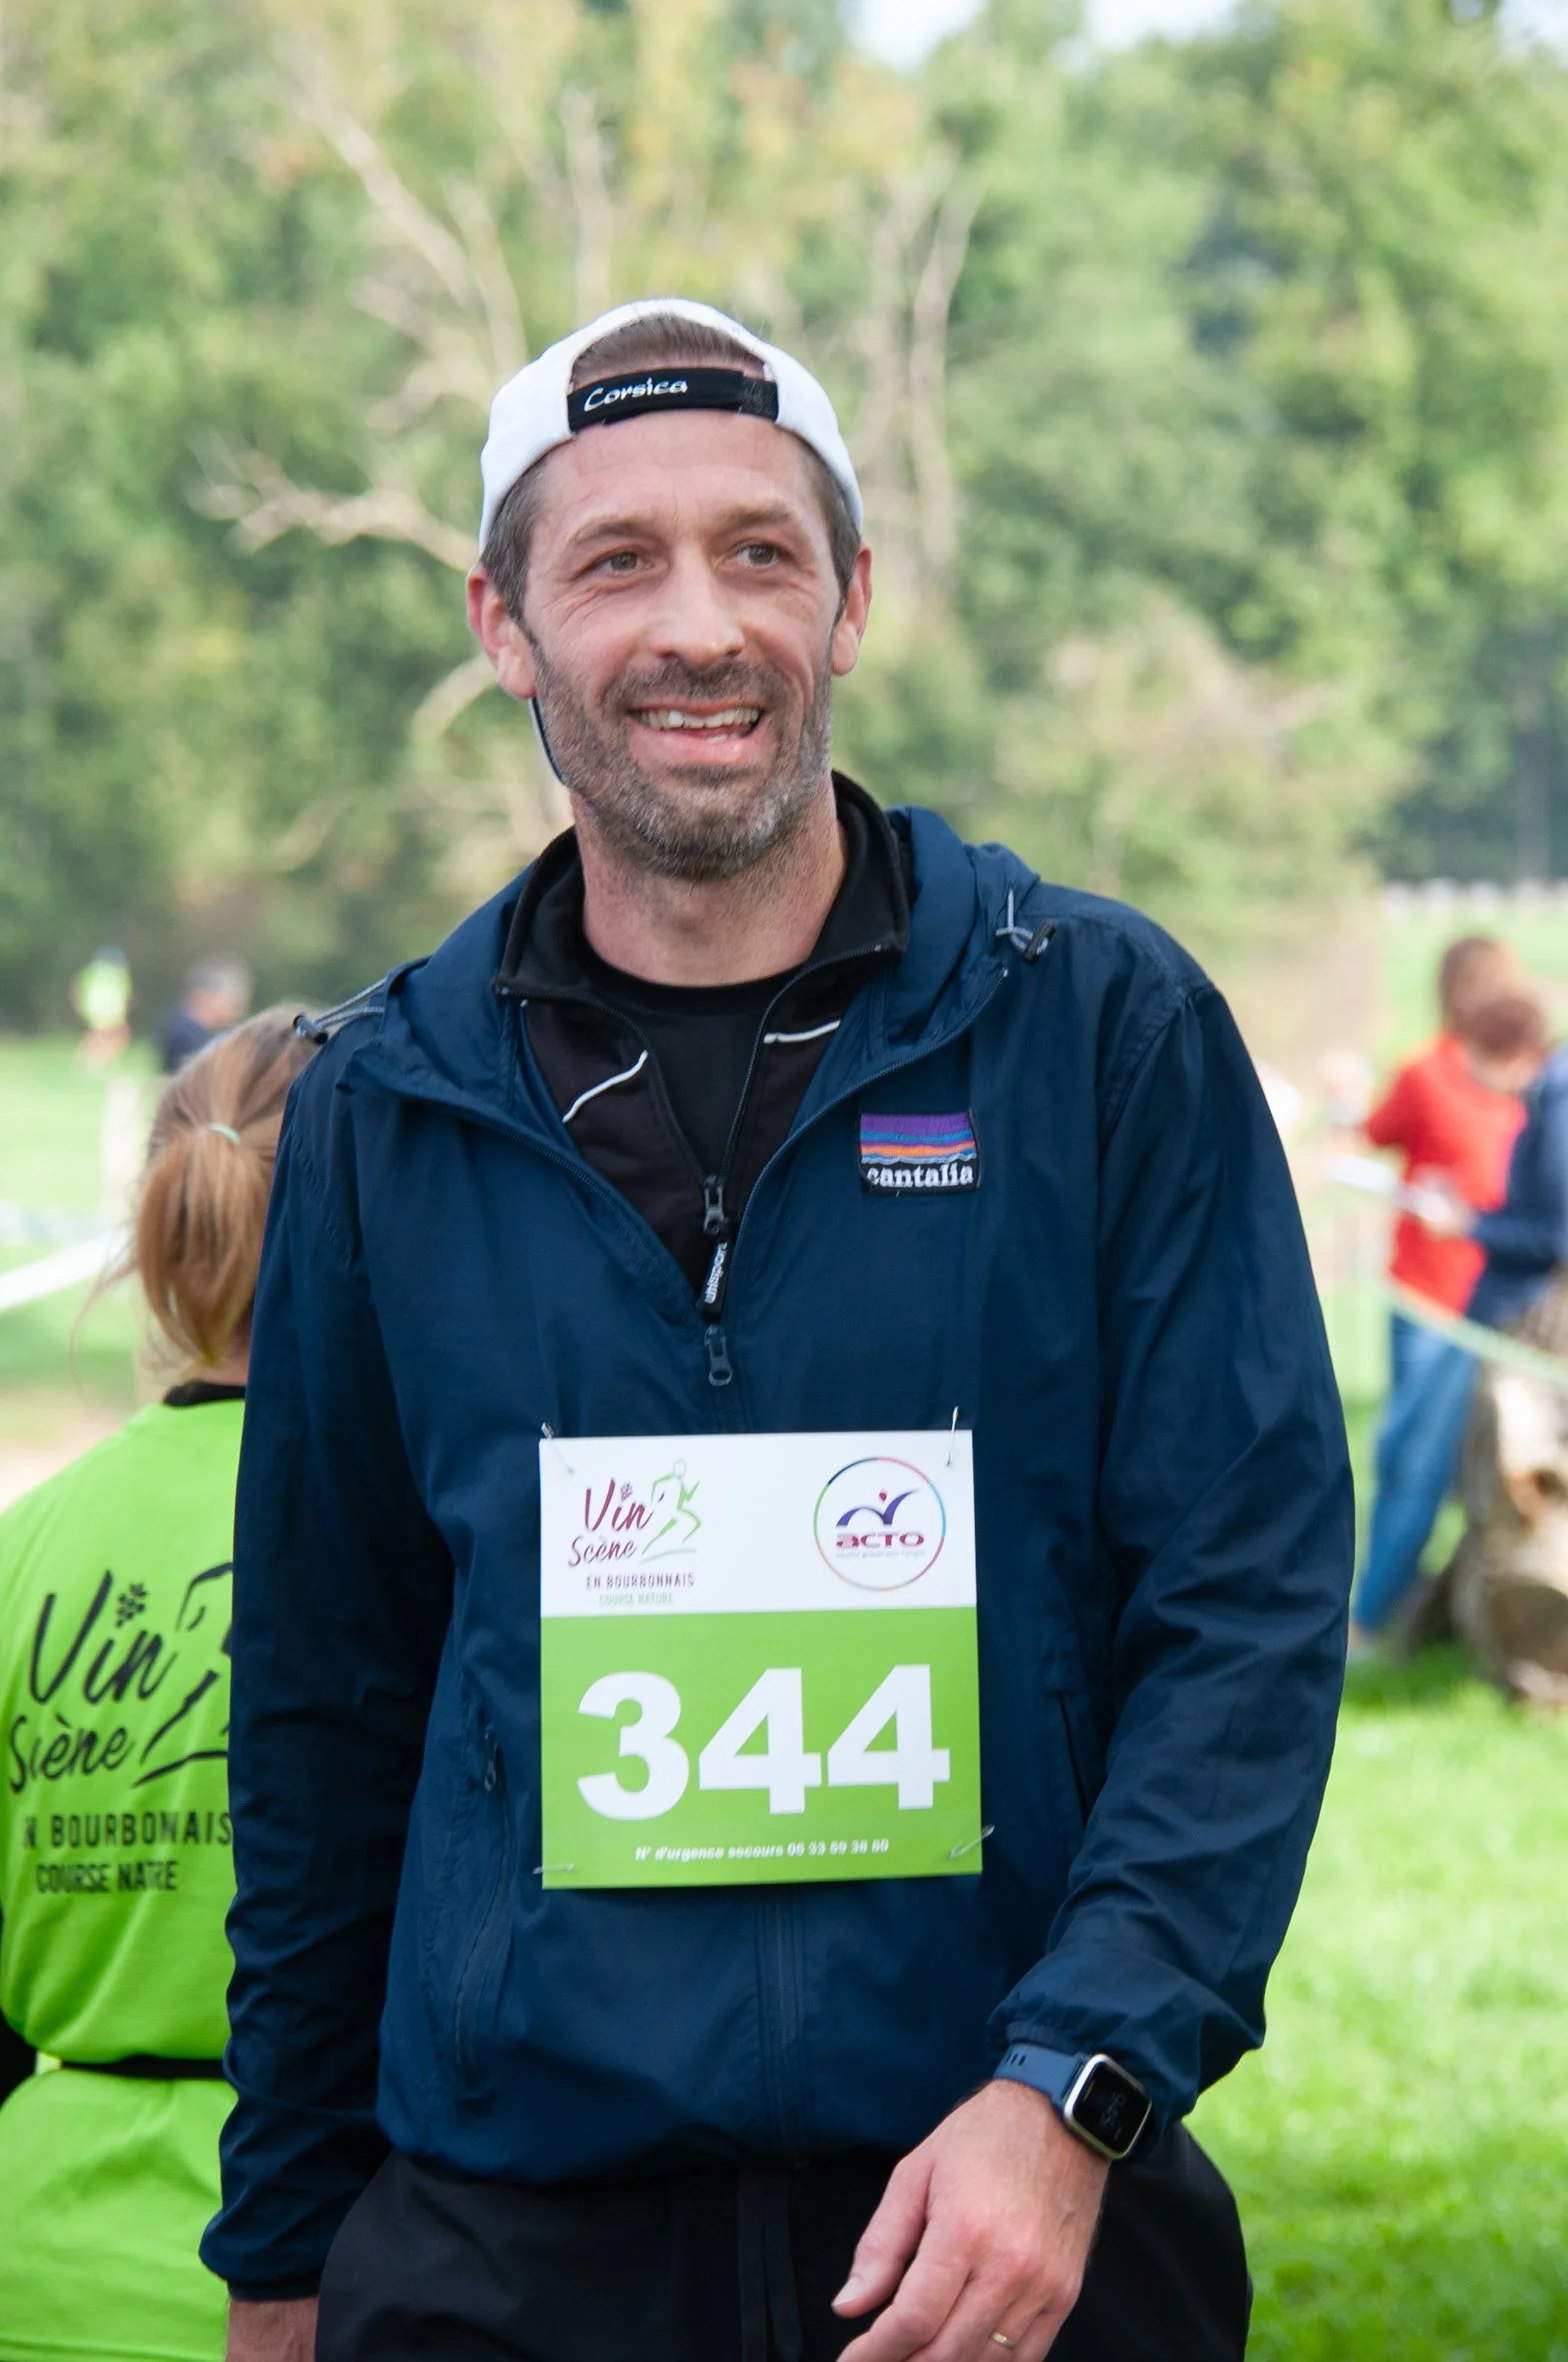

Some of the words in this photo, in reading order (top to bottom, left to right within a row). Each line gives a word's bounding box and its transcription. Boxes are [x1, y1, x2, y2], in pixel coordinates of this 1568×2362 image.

[584, 377, 689, 412] Corsica
[585, 1574, 602, 1590] EN
[606, 1571, 696, 1589] BOURBONNAIS
[576, 1663, 951, 1821] 344
